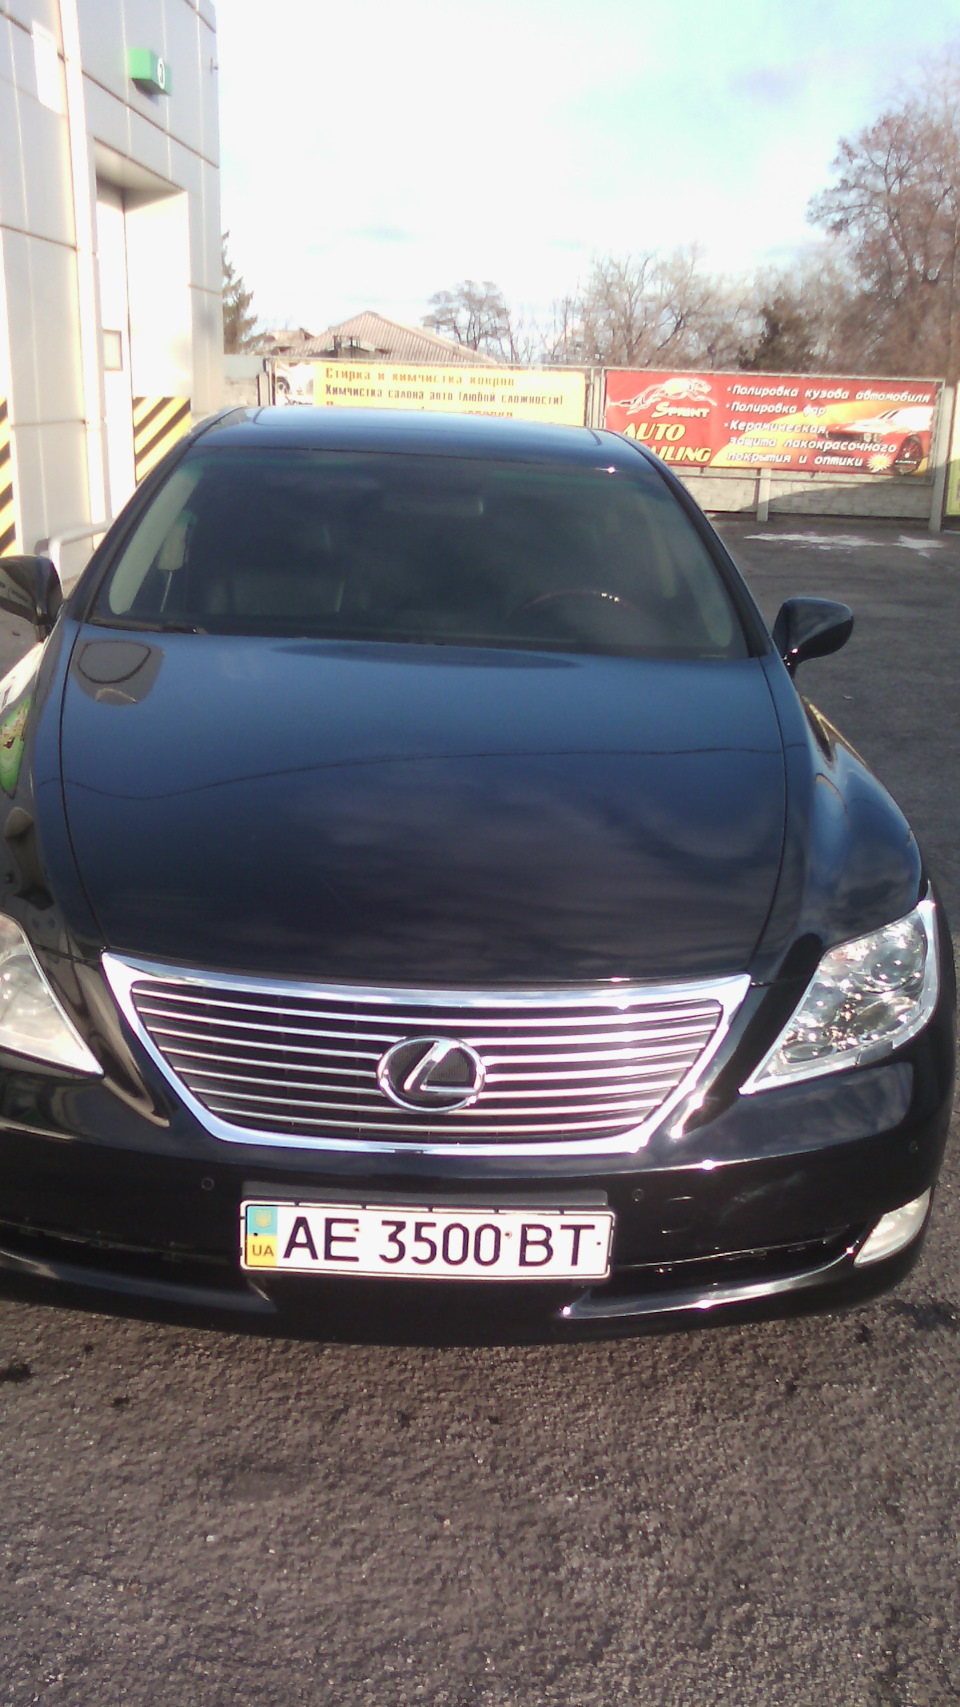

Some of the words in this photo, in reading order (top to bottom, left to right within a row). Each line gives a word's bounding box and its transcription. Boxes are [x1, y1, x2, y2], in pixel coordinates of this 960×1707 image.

[325, 367, 371, 382] Стирка
[378, 372, 385, 381] и
[392, 373, 462, 385] химчистка
[469, 376, 515, 388] ковров
[325, 384, 383, 398] Химчистка
[388, 389, 424, 400] салона
[429, 391, 453, 401] авто
[732, 384, 798, 398] Полировка
[804, 388, 849, 400] кузова
[855, 391, 931, 403] автомобиля
[730, 401, 797, 415] Полировка
[803, 405, 827, 417] фар
[622, 422, 686, 441] AUTO
[729, 437, 776, 448] защита
[784, 440, 897, 453] лакокрасочного
[652, 446, 712, 462] AILING
[728, 452, 791, 464] покрытия
[799, 456, 807, 464] и
[814, 456, 863, 467] оптики
[283, 1217, 359, 1263] AE
[378, 1220, 501, 1267] 3500
[518, 1223, 596, 1267] BT
[252, 1244, 274, 1257] UA
